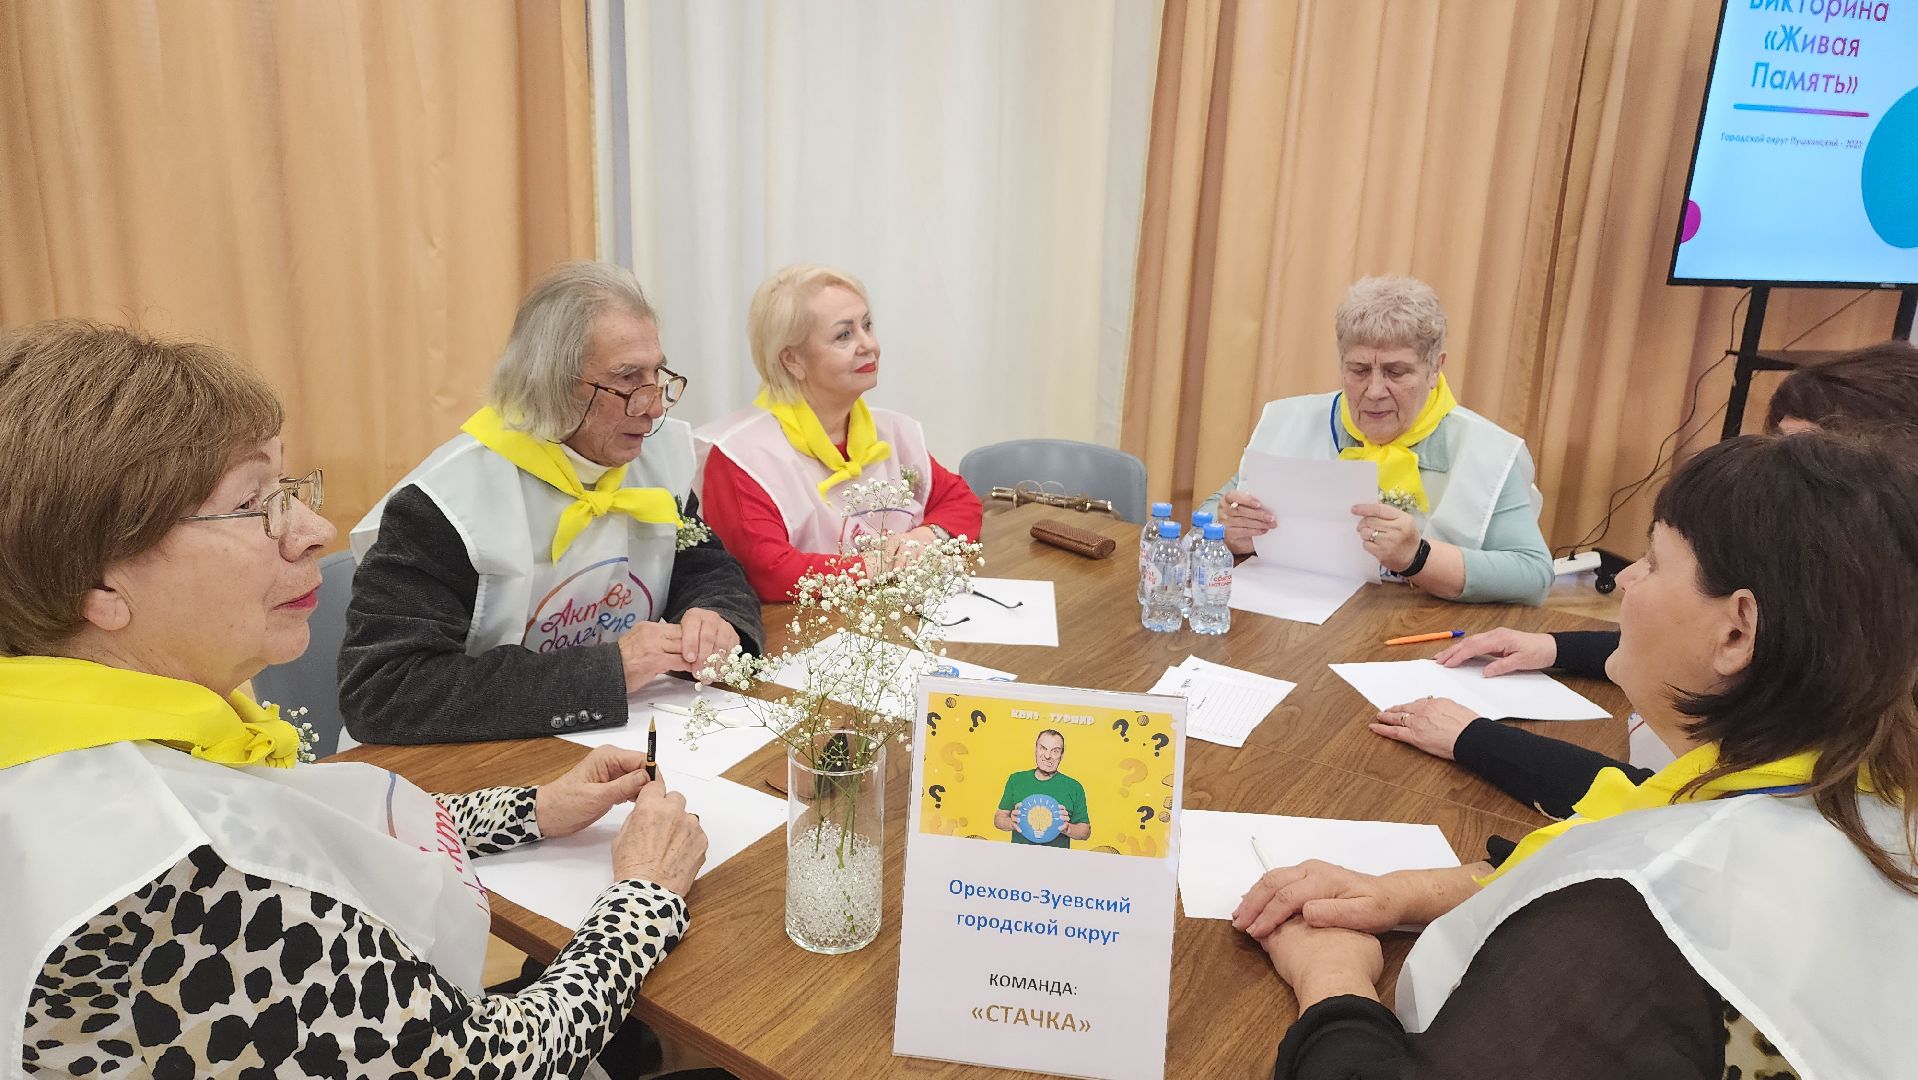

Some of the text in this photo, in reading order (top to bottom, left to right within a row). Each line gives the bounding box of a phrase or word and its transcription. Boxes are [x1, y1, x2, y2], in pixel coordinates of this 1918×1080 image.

[1764, 24, 1861, 58] «Живая
[1751, 61, 1859, 94] Память»
[1720, 132, 1765, 145] Городской
[1766, 135, 1789, 147] округ
[949, 878, 1131, 914] Орехово-Зуевский
[957, 910, 1121, 945] городской округ
[989, 973, 1078, 997] КОМАНДА:
[972, 1003, 1092, 1034] «СТАЧКА»
